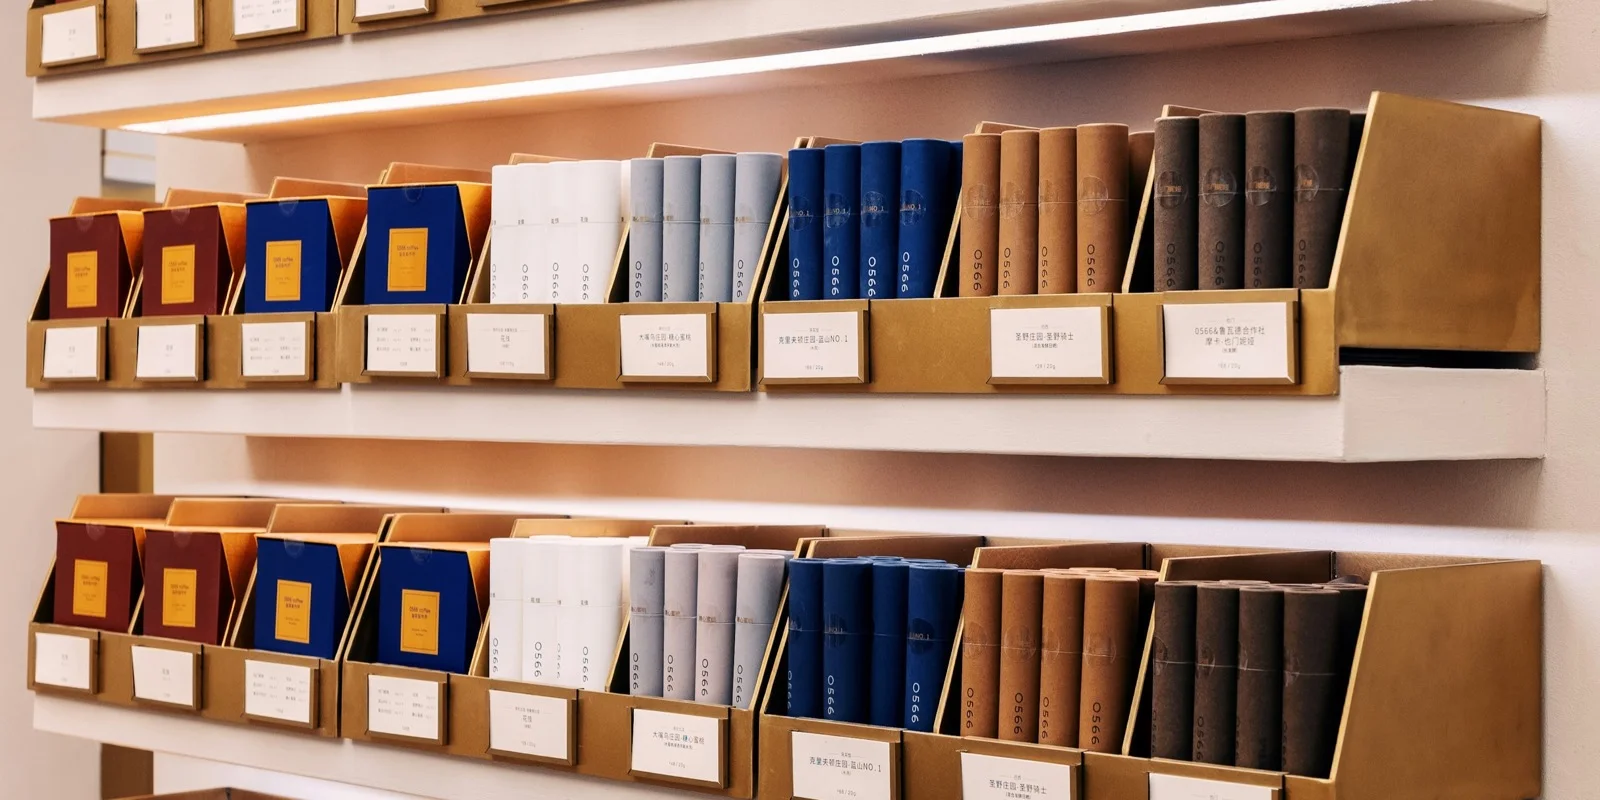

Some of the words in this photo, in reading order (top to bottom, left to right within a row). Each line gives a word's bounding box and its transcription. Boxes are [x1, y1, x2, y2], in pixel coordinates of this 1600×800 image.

[736, 260, 744, 298] 0566
[792, 258, 800, 297] 0566
[831, 255, 839, 296] 0566
[868, 256, 877, 297] 0566
[901, 251, 910, 293] 0566
[973, 249, 983, 291] 0566
[1003, 247, 1011, 289] 0566
[1086, 244, 1095, 287] 0566
[1166, 243, 1176, 287] 0566
[1215, 241, 1225, 286] 0566
[911, 682, 920, 723] 0566
[966, 687, 974, 729] 0566
[1014, 692, 1023, 734] 0566
[1041, 697, 1049, 739] 0566
[1091, 702, 1101, 745] 0566
